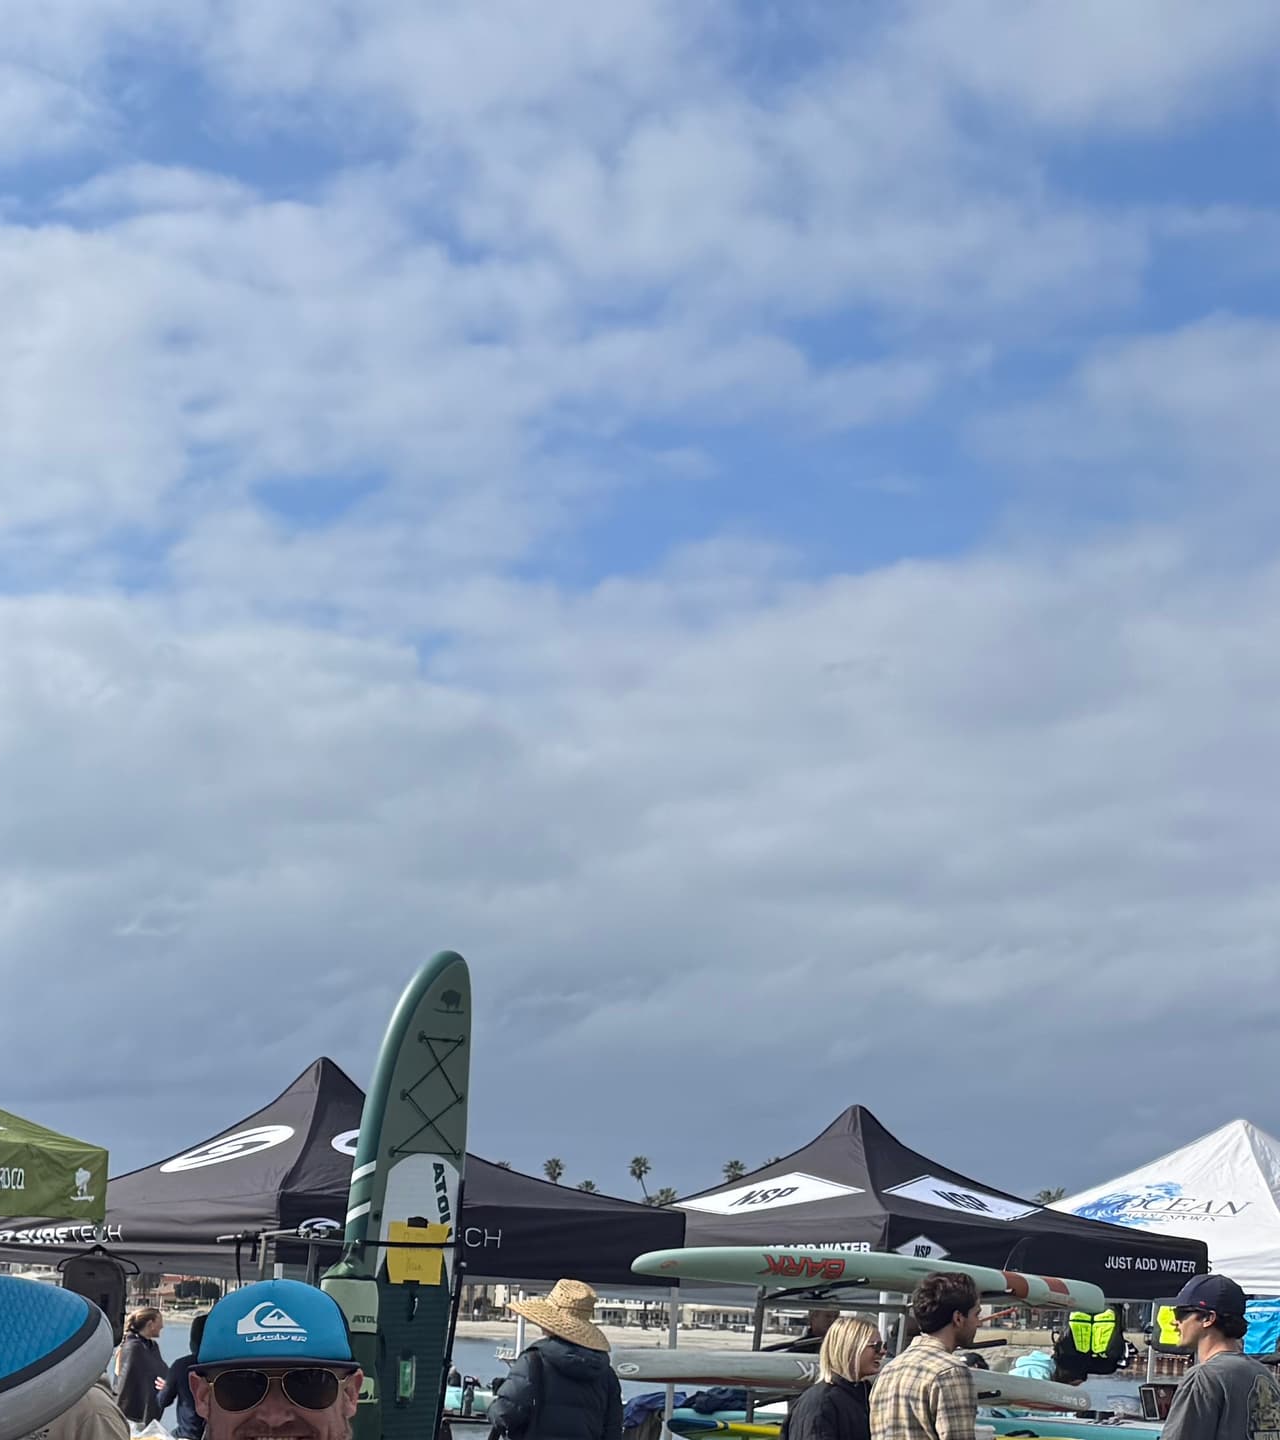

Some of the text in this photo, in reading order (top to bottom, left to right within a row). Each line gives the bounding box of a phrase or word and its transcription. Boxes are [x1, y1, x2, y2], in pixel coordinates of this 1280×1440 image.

[729, 1186, 800, 1208] NSP
[1128, 1197, 1256, 1216] OCEAN
[914, 1244, 931, 1258] NSP
[755, 1254, 846, 1279] BARK
[1104, 1256, 1134, 1270] JUST
[1135, 1257, 1157, 1272] ADD
[1160, 1259, 1197, 1274] WATER
